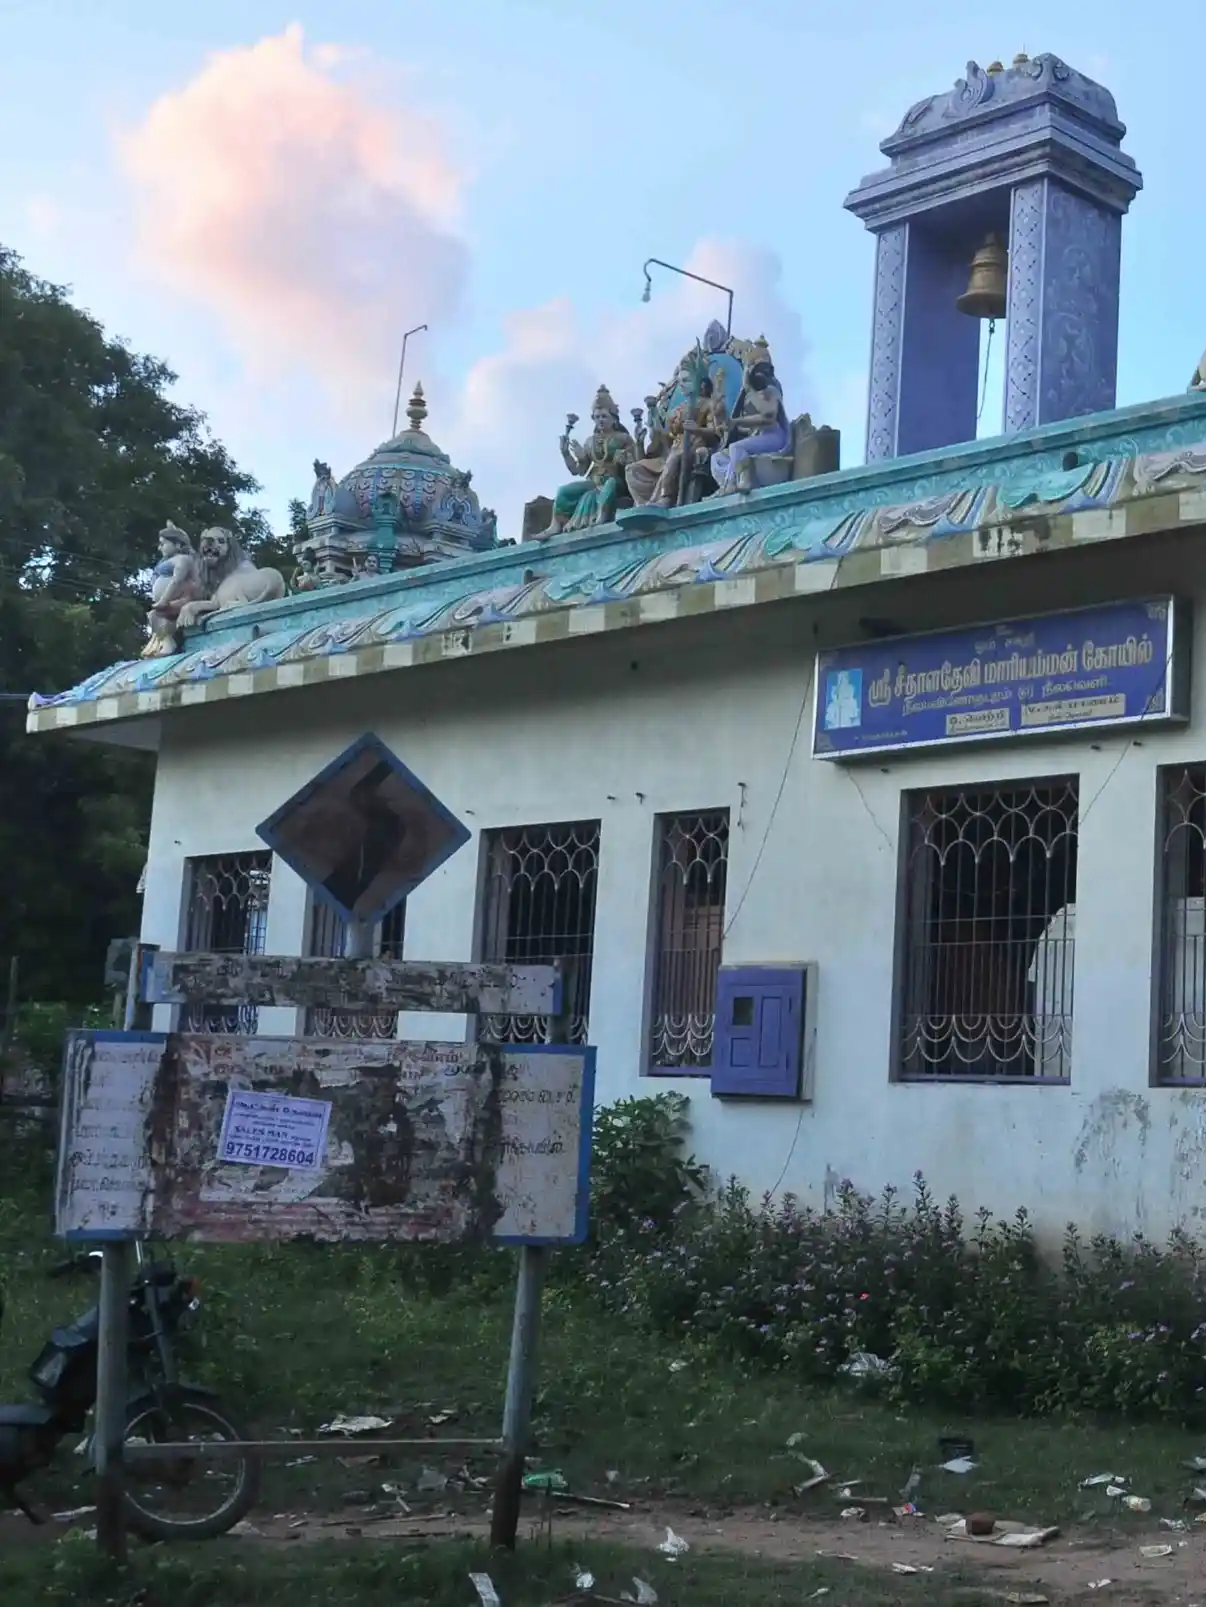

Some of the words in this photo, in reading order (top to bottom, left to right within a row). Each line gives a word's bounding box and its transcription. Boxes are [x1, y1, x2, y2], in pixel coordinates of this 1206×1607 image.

[984, 643, 1078, 684] மாரியம்மன்
[1082, 631, 1154, 671] கோயில்
[226, 1141, 314, 1164] 9751728604
